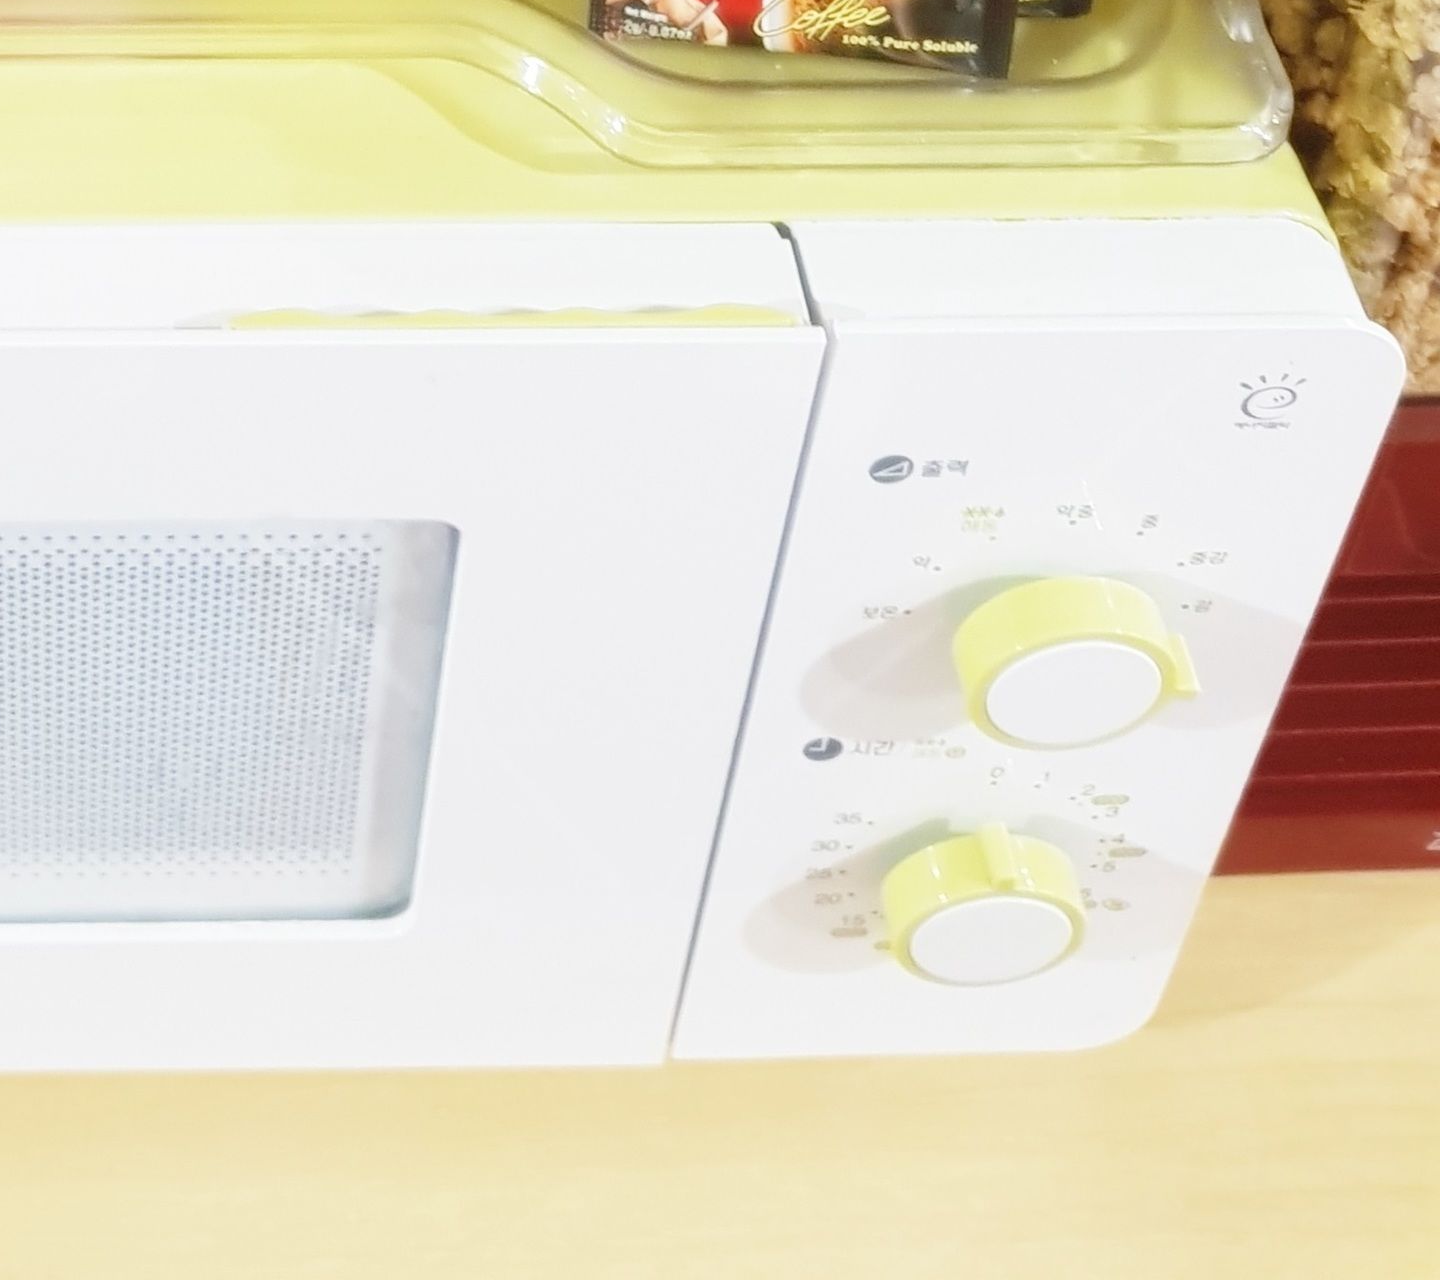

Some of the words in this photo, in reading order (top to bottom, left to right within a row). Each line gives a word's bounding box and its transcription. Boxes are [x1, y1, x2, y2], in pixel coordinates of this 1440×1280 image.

[843, 34, 880, 48] 100%
[883, 36, 921, 51] Pure
[922, 39, 979, 54] Soluble
[833, 812, 863, 825] 35
[811, 839, 841, 852] 30
